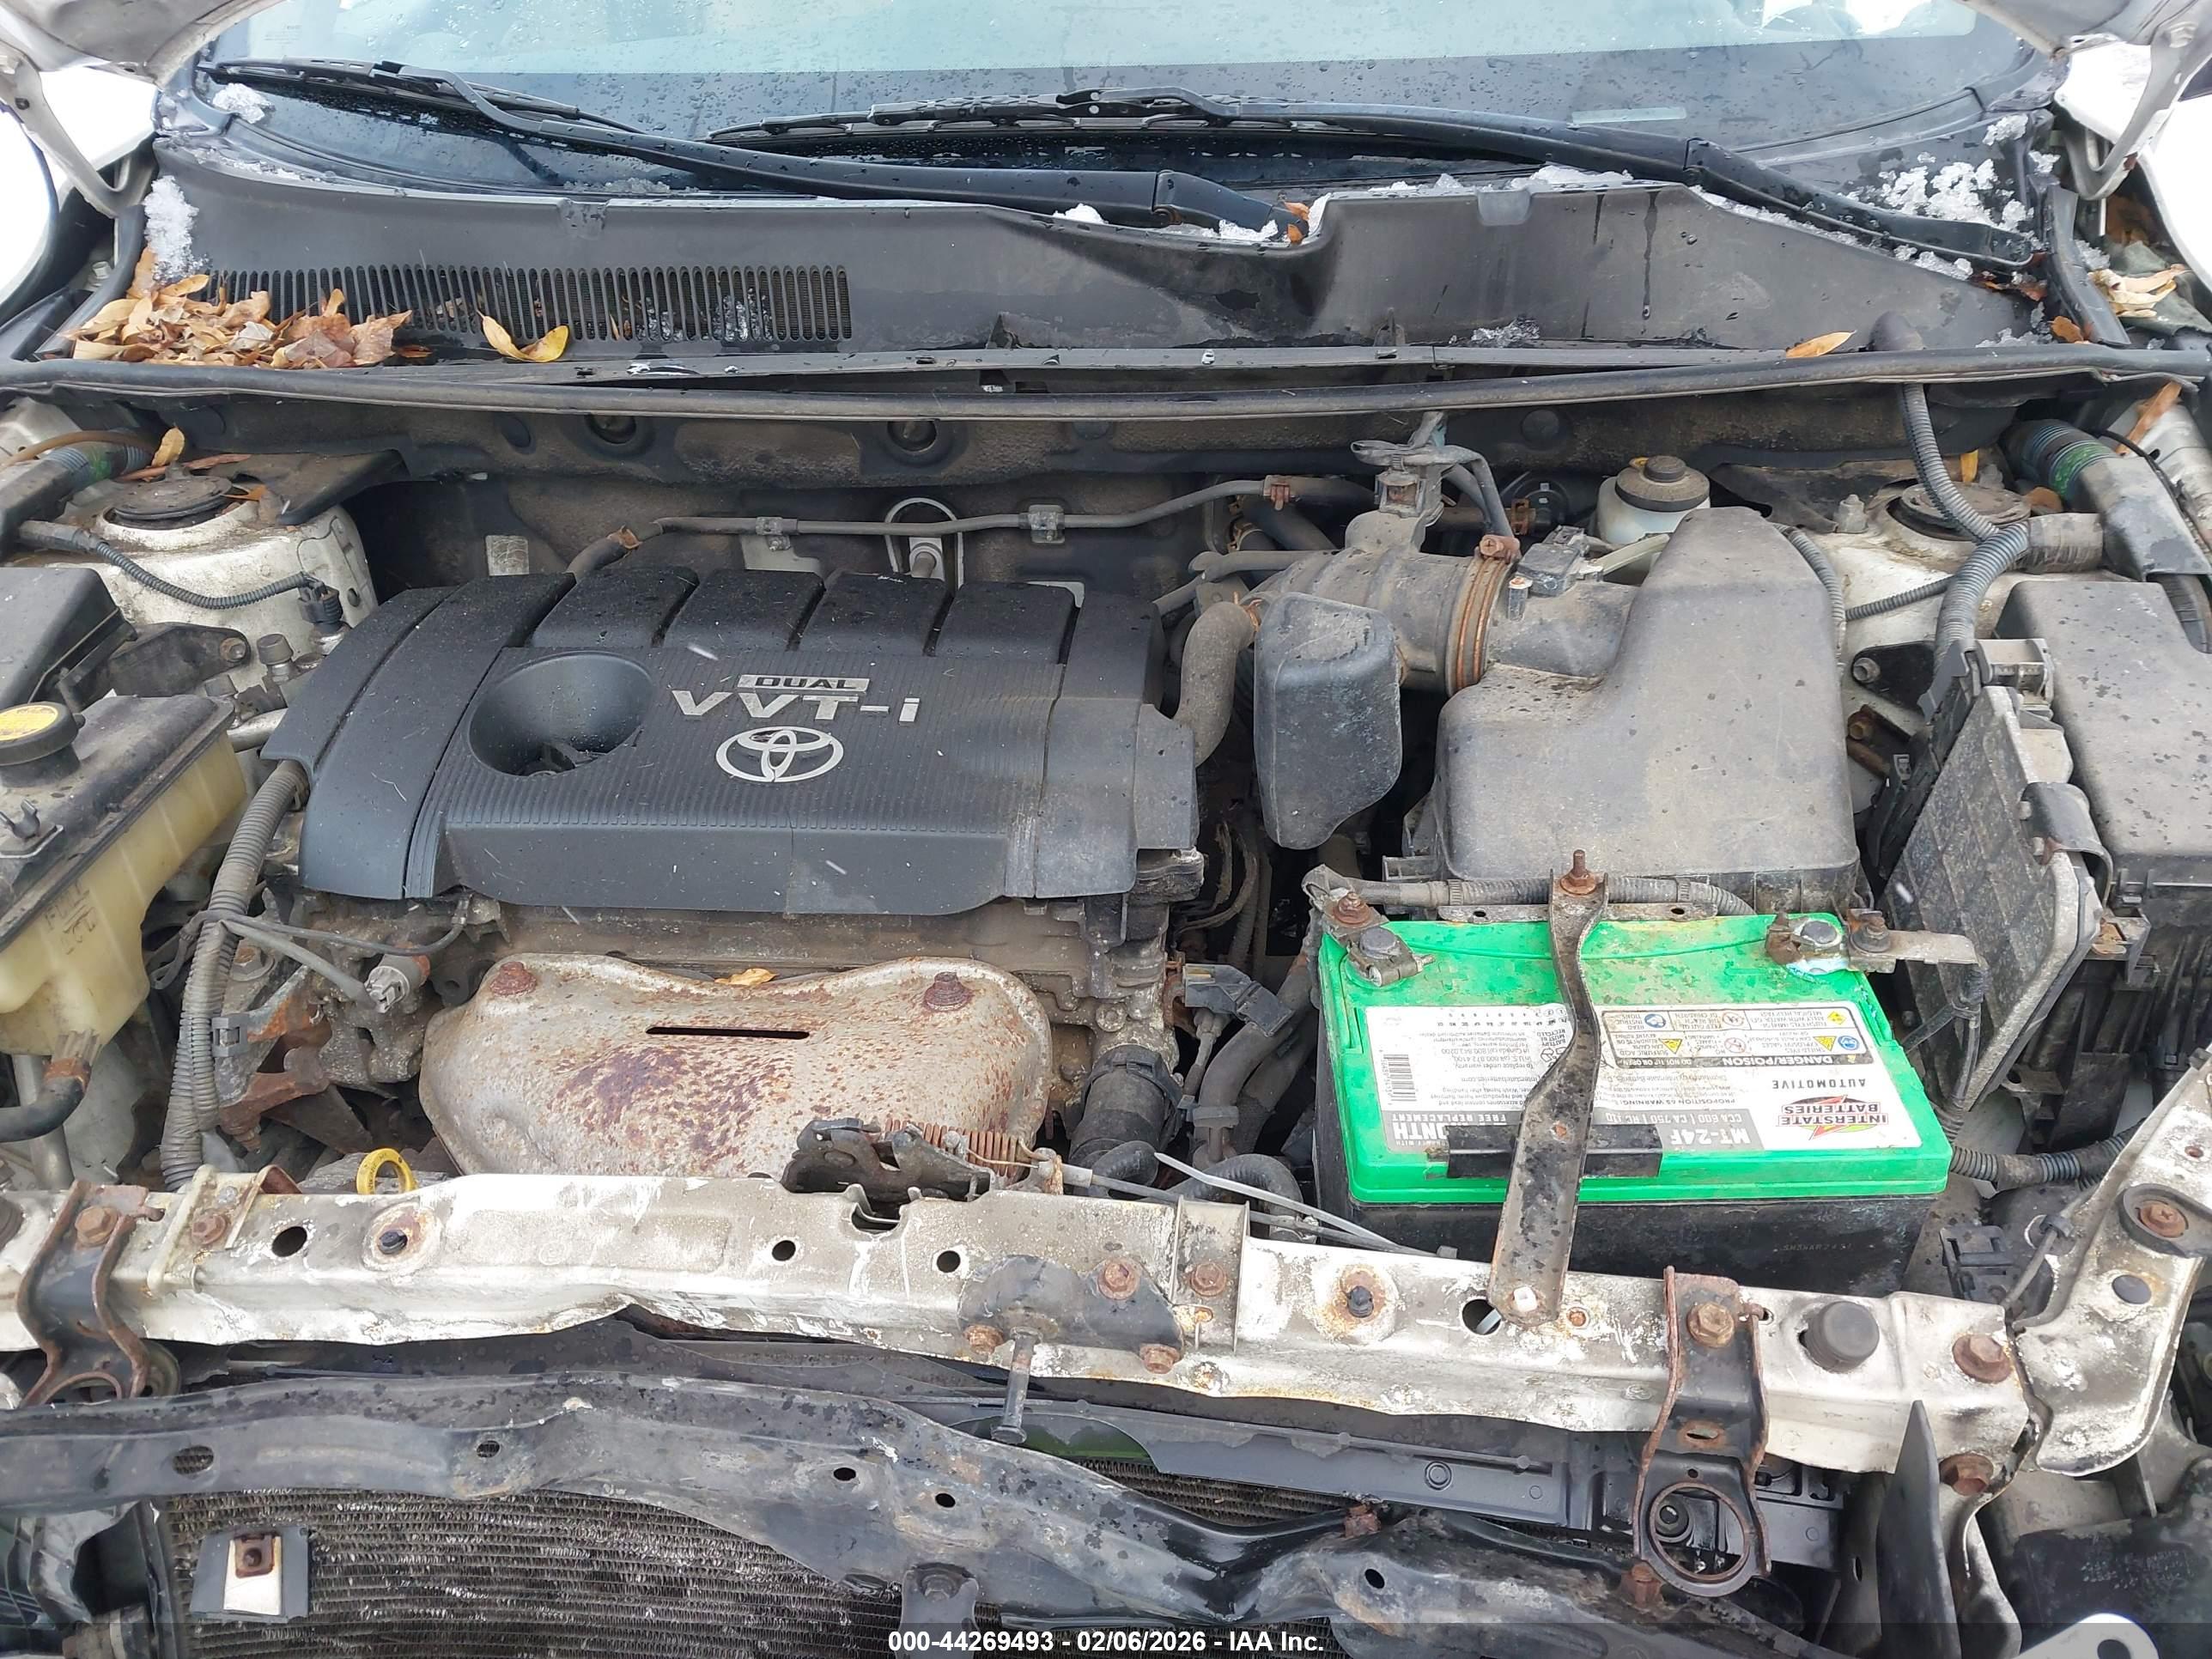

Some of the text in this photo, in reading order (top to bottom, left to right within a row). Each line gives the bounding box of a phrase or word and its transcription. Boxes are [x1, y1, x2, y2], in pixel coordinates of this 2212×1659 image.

[756, 676, 857, 690] DUAL
[672, 690, 921, 724] VVT-i
[1721, 1055, 1833, 1066] DANGER/POISON
[1772, 1079, 1866, 1089] AUTOMOTIVE
[1783, 1103, 1879, 1115] BATTERIES
[1391, 1113, 1474, 1121] REPLACEMENT
[1650, 1114, 1671, 1123] 750
[1673, 1114, 1686, 1123] CA
[1698, 1113, 1717, 1123] 600
[1720, 1113, 1742, 1123] CCA
[1782, 1115, 1887, 1126] INTERSTATE
[1669, 1128, 1752, 1146] MT-24F
